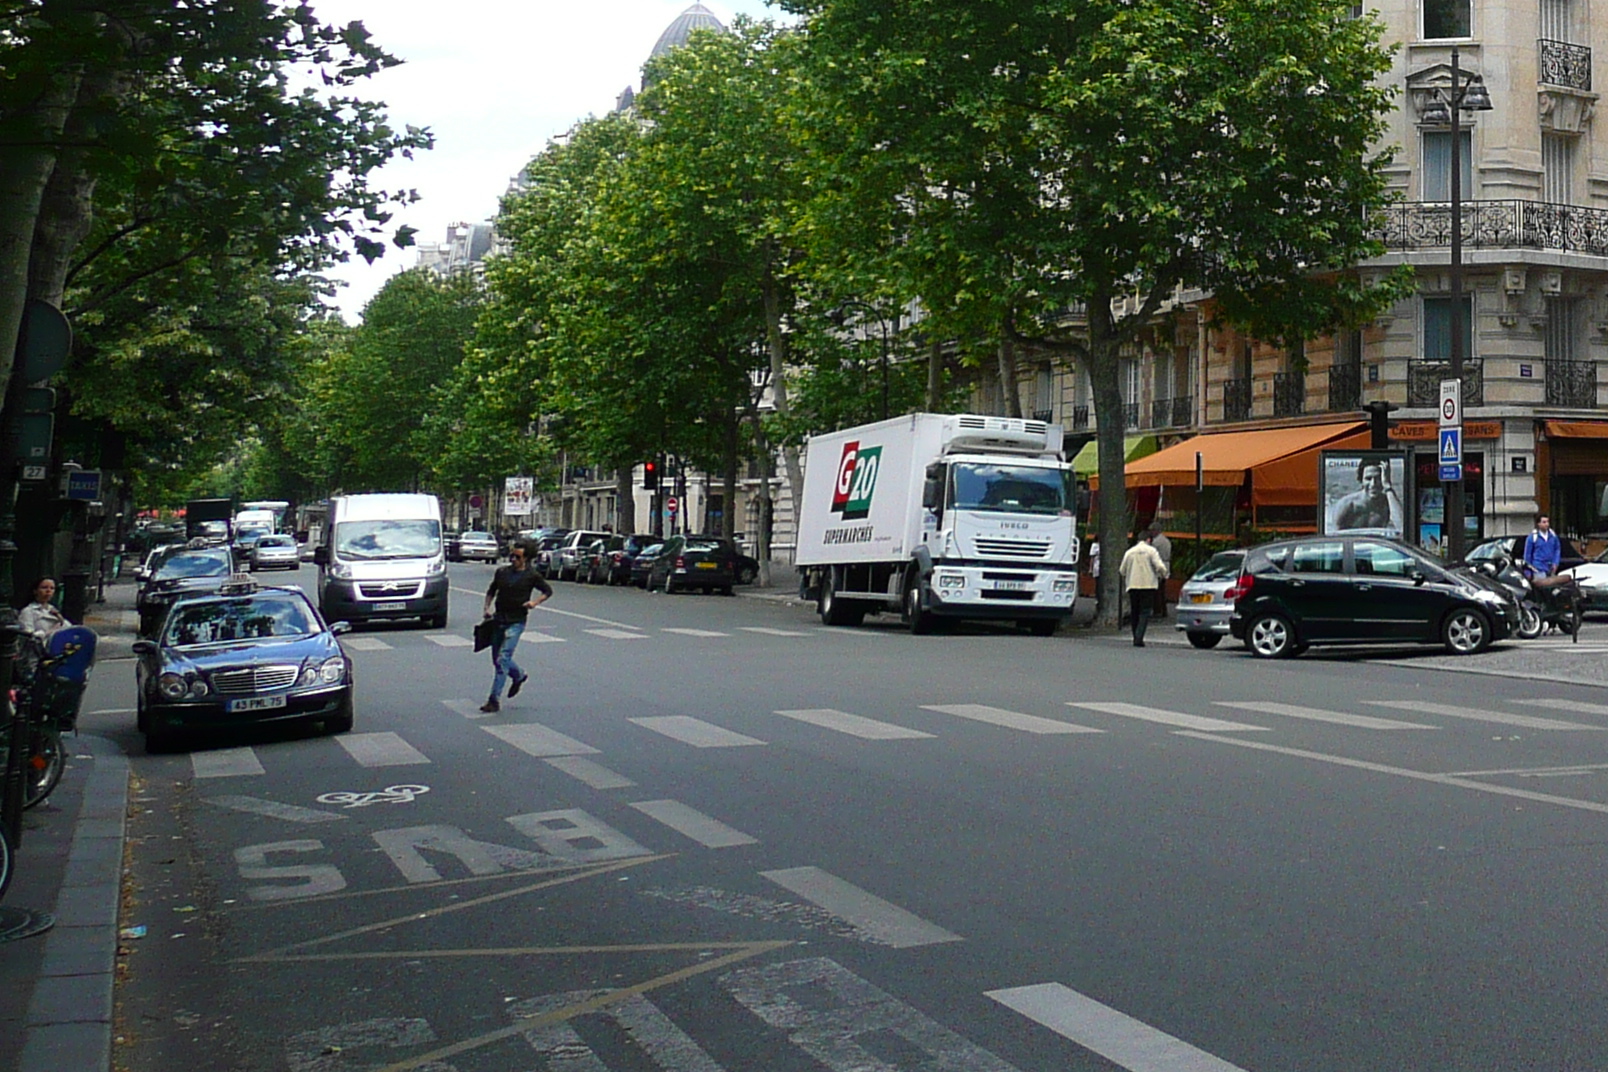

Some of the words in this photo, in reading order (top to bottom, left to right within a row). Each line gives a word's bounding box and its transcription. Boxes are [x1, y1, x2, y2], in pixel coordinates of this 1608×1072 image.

[1392, 426, 1424, 436] CAVES
[1328, 460, 1360, 468] CHANEL
[26, 469, 42, 477] 27
[838, 450, 877, 501] G20
[1000, 522, 1029, 530] IVECO
[234, 697, 247, 710] 43
[269, 695, 283, 706] 75
